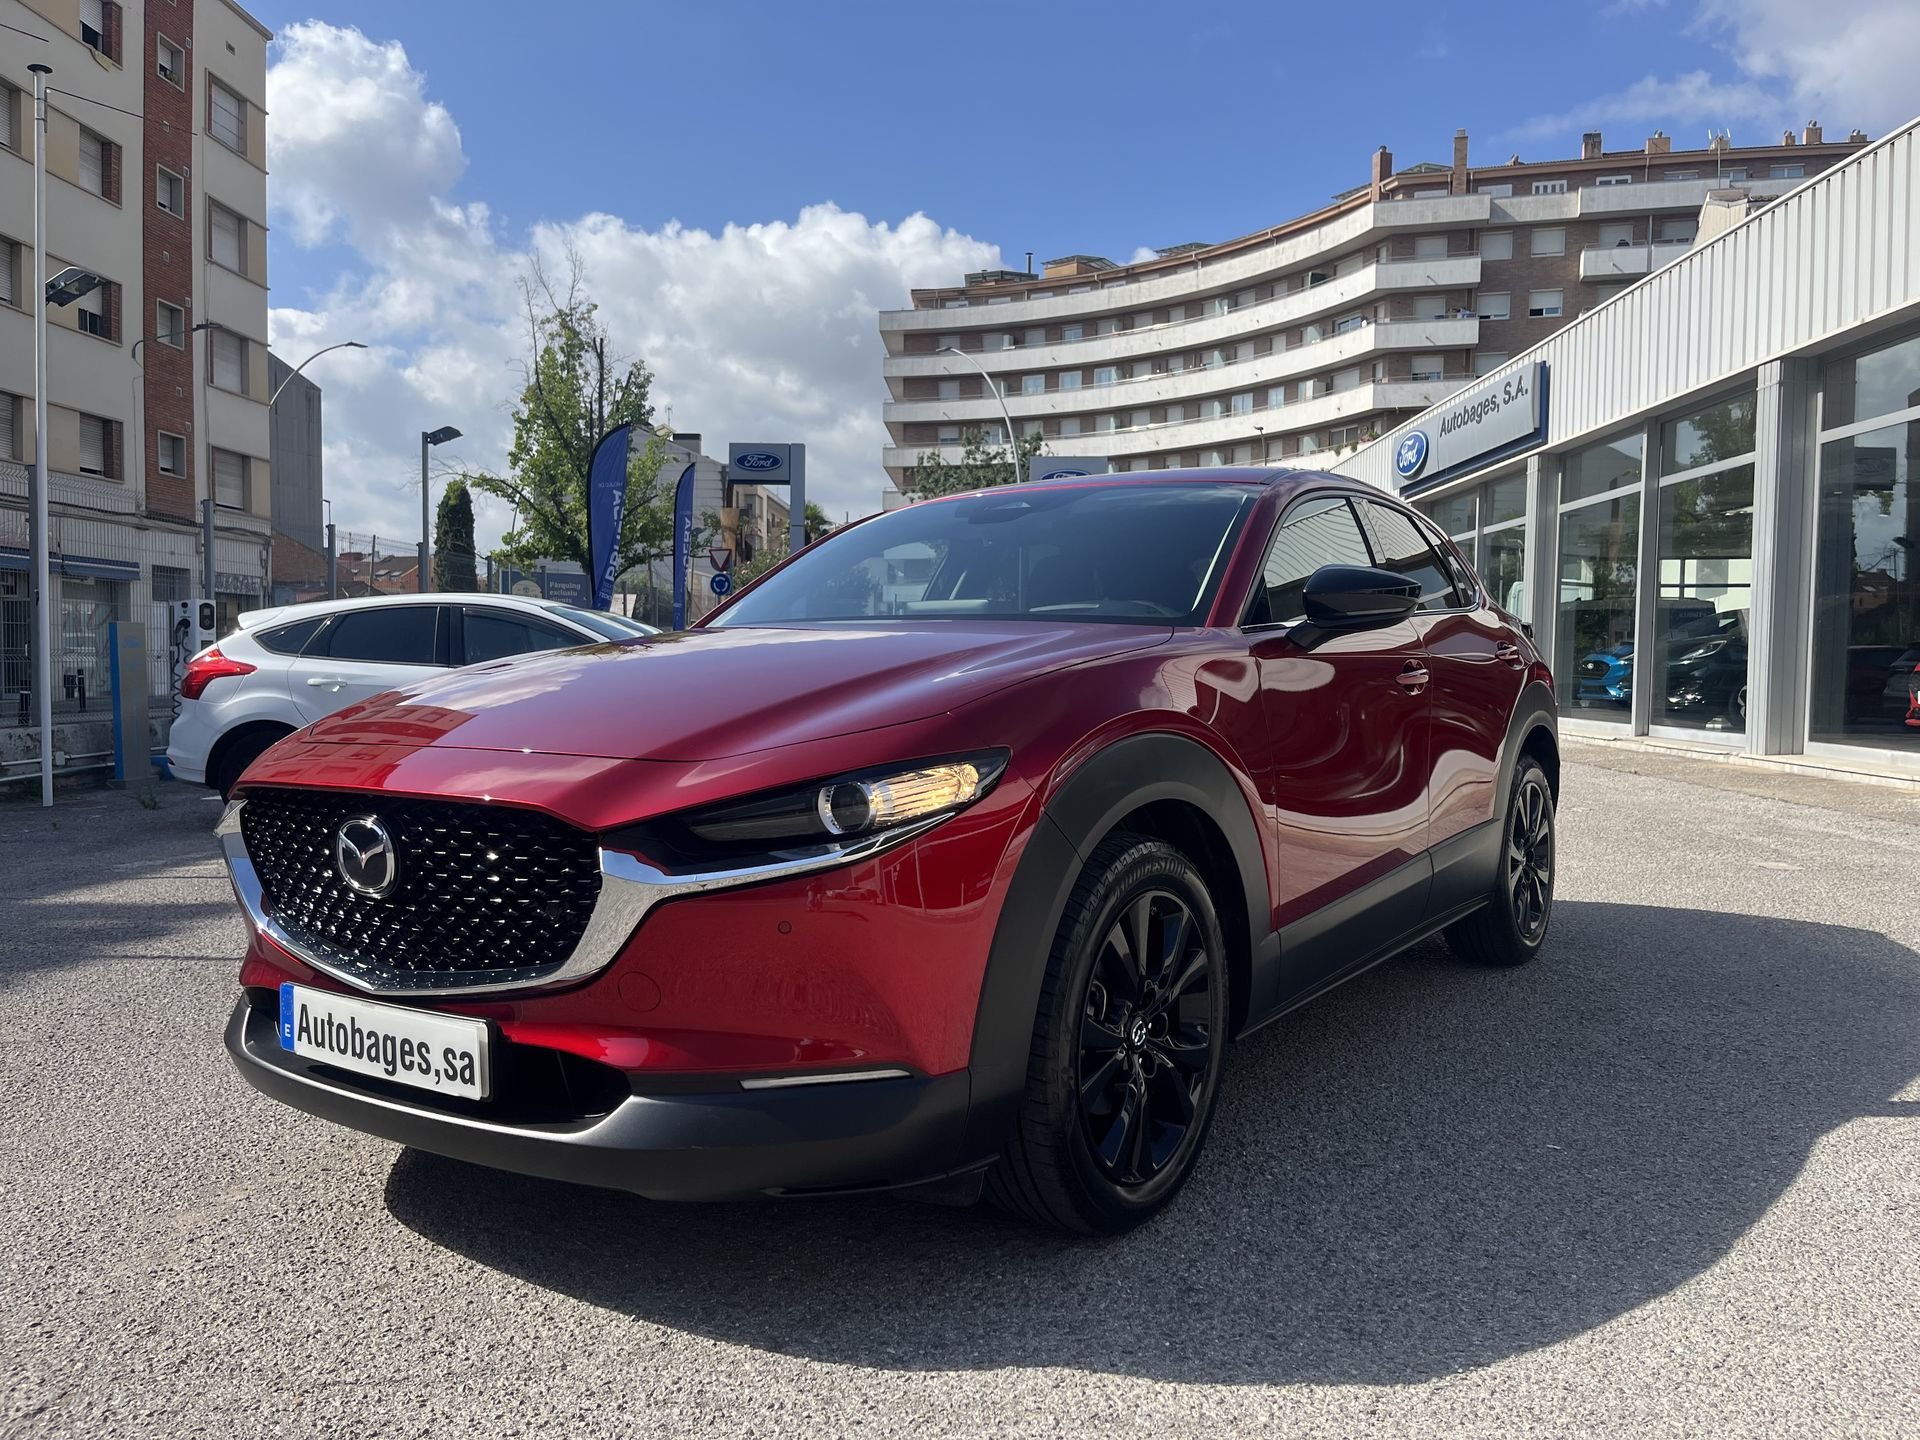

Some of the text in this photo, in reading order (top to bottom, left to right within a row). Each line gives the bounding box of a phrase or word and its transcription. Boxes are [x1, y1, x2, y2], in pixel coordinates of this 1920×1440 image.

[1440, 375, 1529, 438] Autobages, S.A.
[284, 1023, 291, 1038] E
[297, 1003, 476, 1086] Autobages,sa
